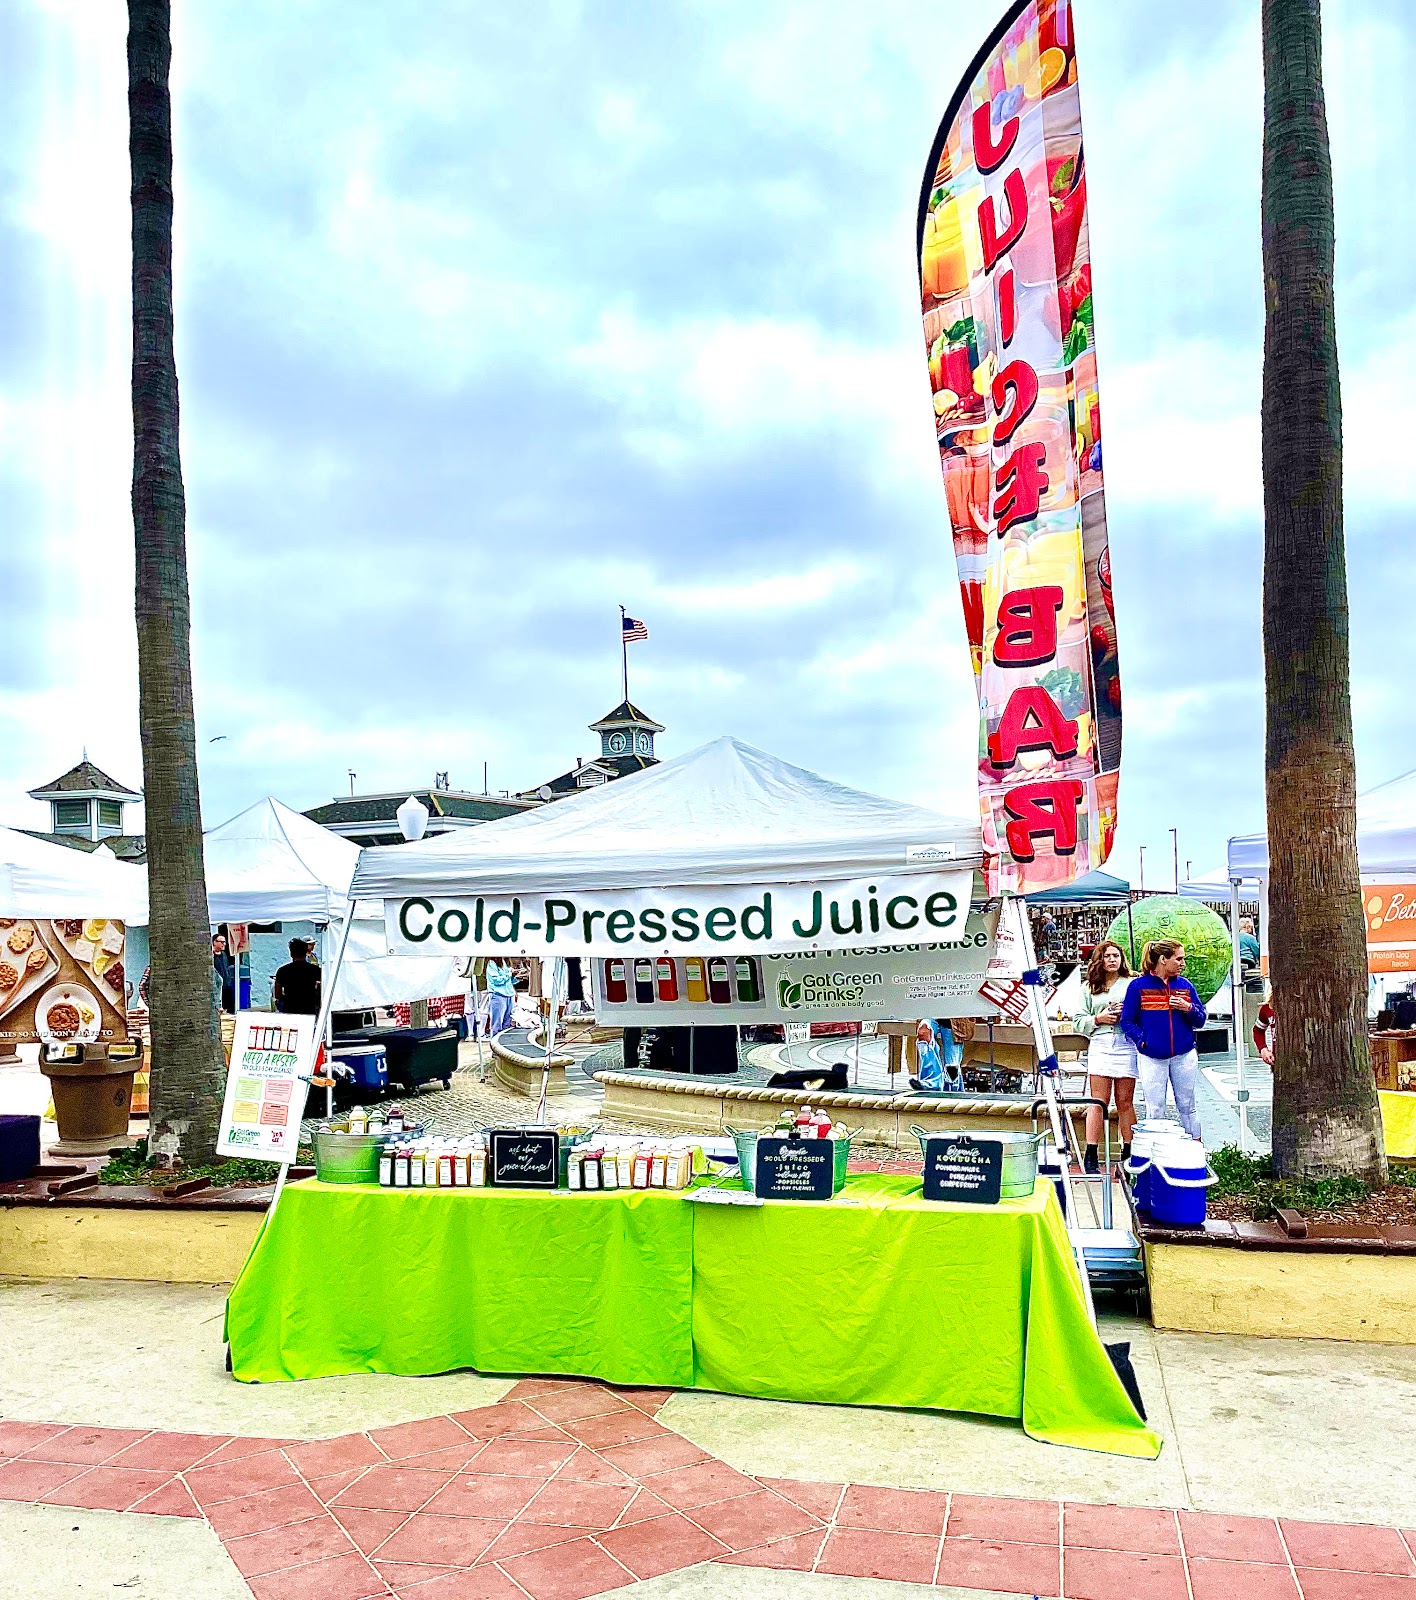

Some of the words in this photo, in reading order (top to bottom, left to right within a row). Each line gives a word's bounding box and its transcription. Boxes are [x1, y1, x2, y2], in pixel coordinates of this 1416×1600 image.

[399, 892, 772, 943] Cold-Pressed
[792, 885, 958, 938] Juice
[1396, 951, 1410, 959] Dog
[893, 973, 985, 984] GotGreenDrinks.com
[804, 986, 864, 1002] Drinks?
[31, 1030, 49, 1038] YOU
[50, 1029, 76, 1037] DON'T
[242, 1051, 264, 1065] NEED
[264, 1053, 271, 1065] A
[936, 1155, 991, 1164] KOMBUCHA
[949, 1173, 987, 1182] PINEAPPLE
